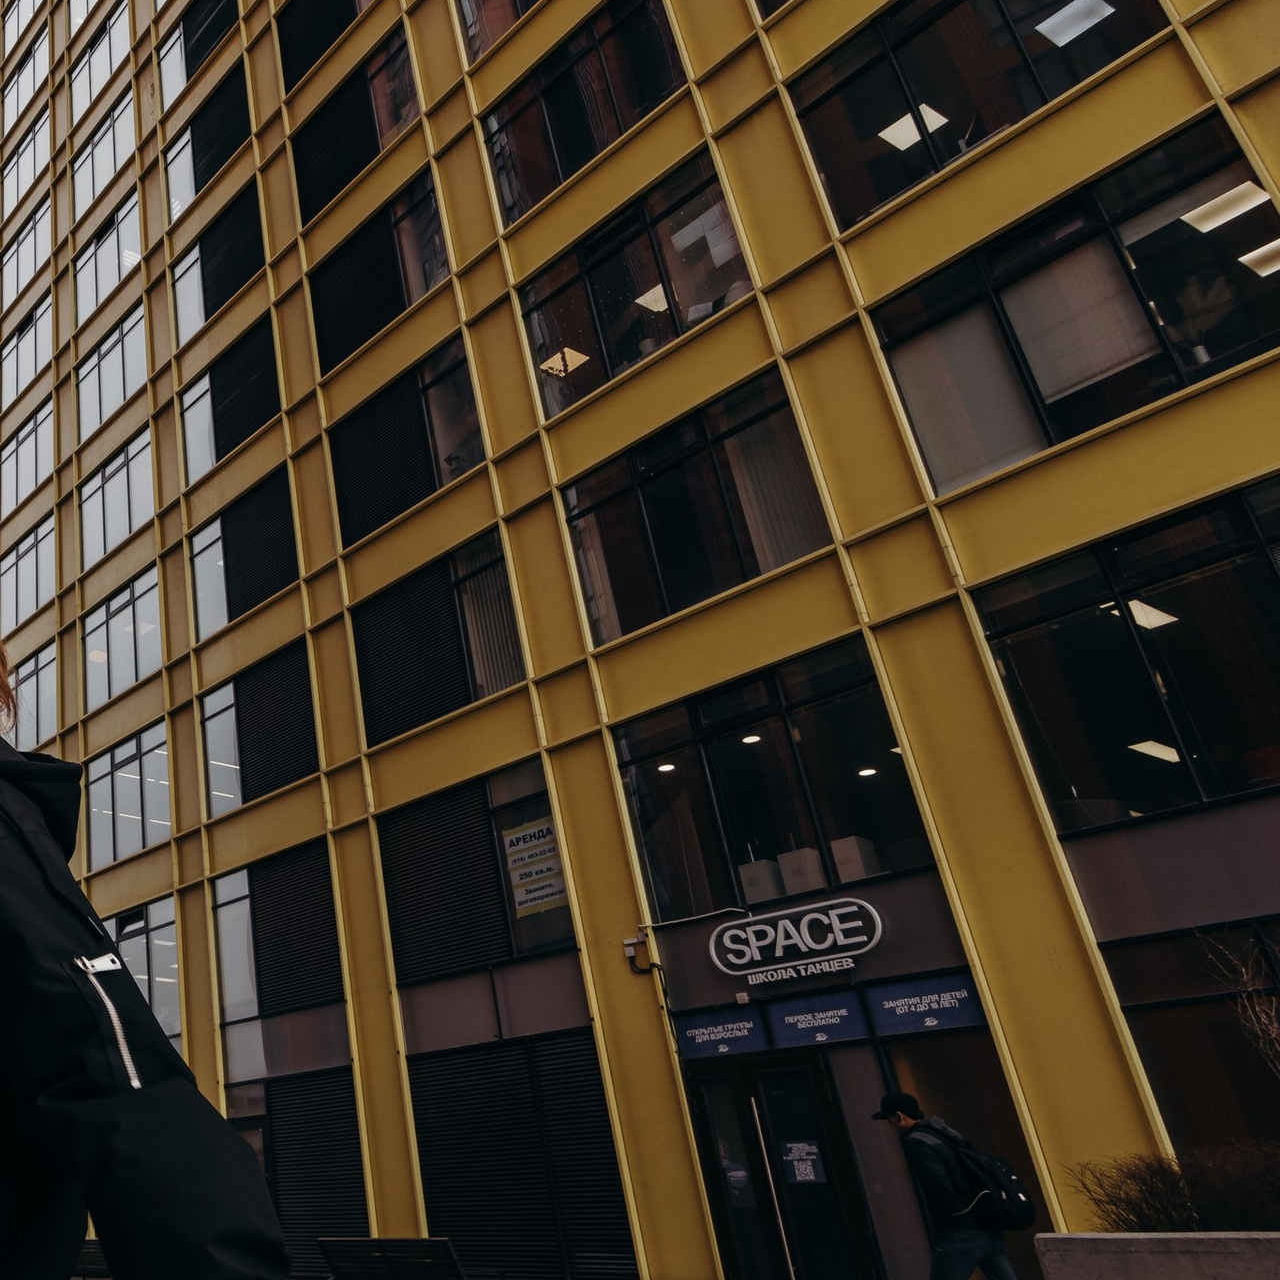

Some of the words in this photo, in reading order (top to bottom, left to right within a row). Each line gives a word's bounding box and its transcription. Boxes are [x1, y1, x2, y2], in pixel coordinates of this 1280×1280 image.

[508, 827, 554, 849] АРЕНДА
[519, 870, 533, 881] 250
[723, 905, 868, 965] SPACE
[747, 967, 798, 985] ШКОЛА
[797, 957, 855, 977] ТАНЦЕВ
[882, 996, 921, 1009] ЗАНЯТИЯ
[922, 994, 939, 1003] ДЛЯ
[940, 989, 968, 1001] ДЕТЕЙ
[895, 1005, 909, 1015] (ОТ
[910, 1004, 916, 1012] 4
[916, 1003, 929, 1012] ДО
[930, 1002, 939, 1010] 16
[939, 999, 959, 1008] ЛЕТ)
[784, 1013, 814, 1024] ПЕРВОЕ
[813, 1008, 849, 1020] ЗАНЯТИЕ
[797, 1017, 840, 1029] БЕСПЛАТНО
[686, 1025, 724, 1037] ОТКРЫТЫЕ
[724, 1021, 754, 1032] ГРУППЫ
[695, 1035, 710, 1043] ДЛЯ
[710, 1029, 749, 1041] ВЗРОСЛЫХ
